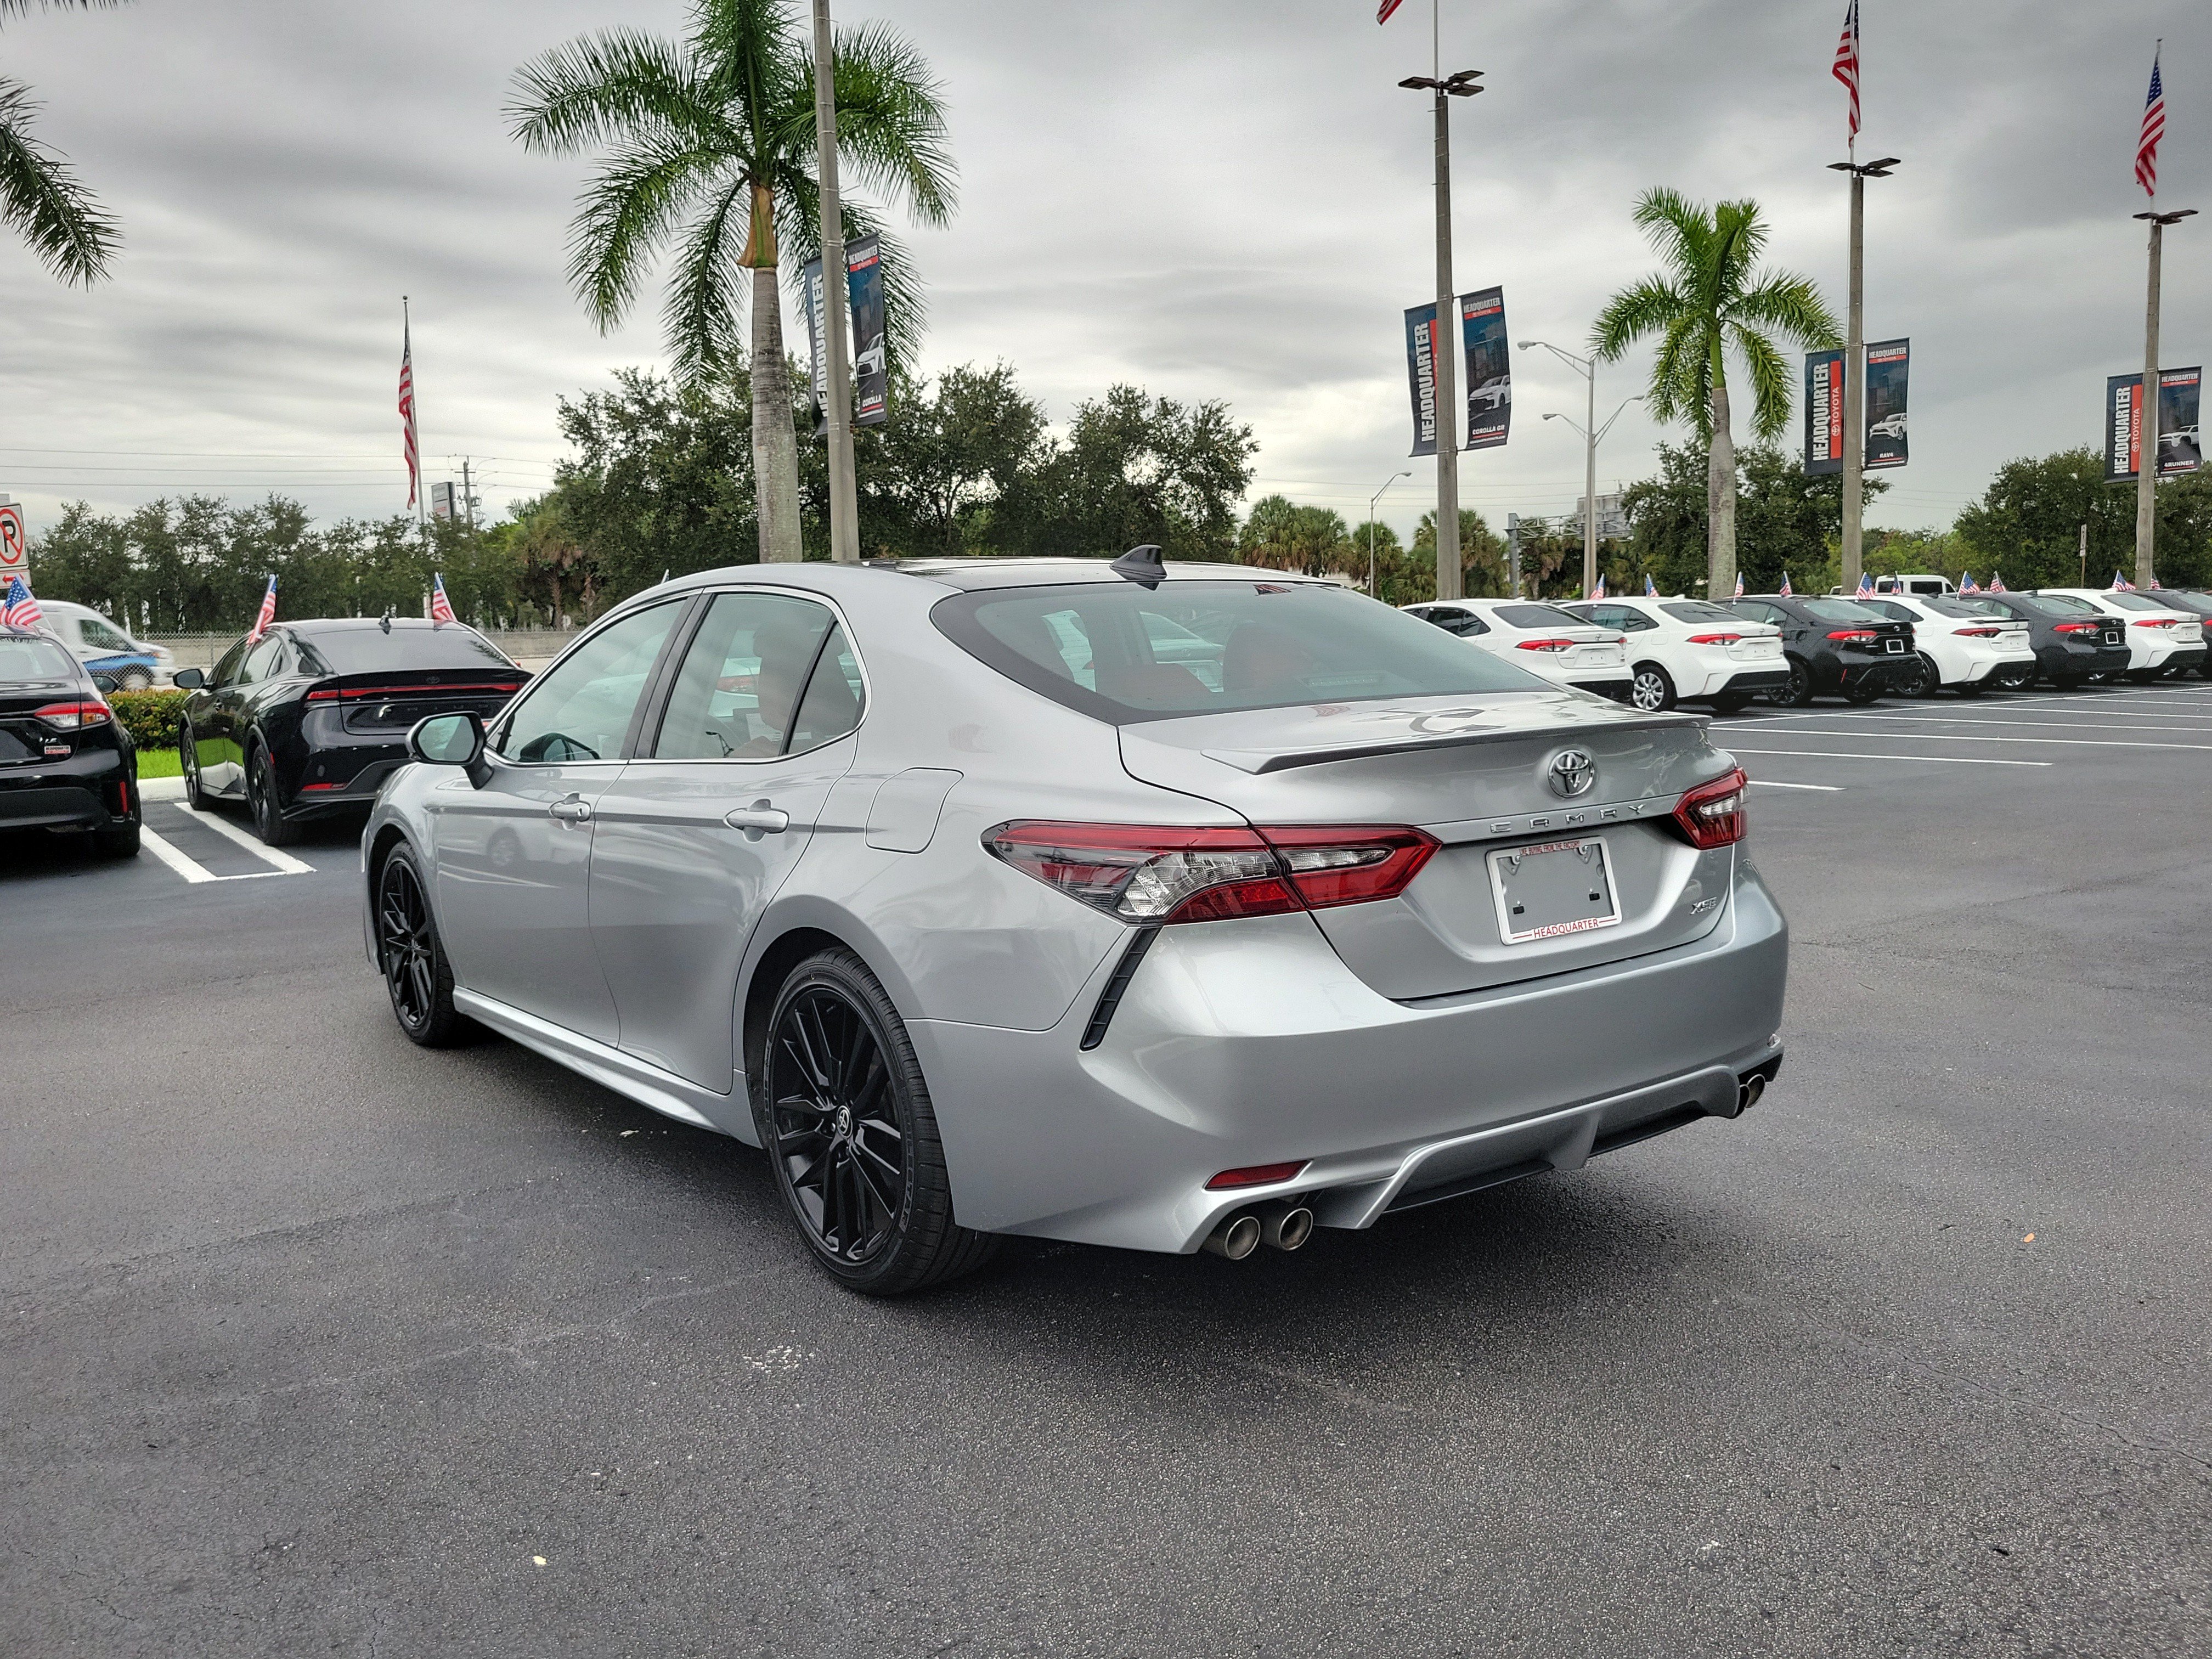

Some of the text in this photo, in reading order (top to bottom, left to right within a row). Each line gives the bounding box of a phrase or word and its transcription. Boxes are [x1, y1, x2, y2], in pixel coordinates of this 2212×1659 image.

[1464, 297, 1500, 313] HEADQUARTER
[1869, 347, 1906, 358] HEADQUARTER
[1414, 323, 1435, 442] HEADQUARTER
[2162, 374, 2198, 382] HEADQUARTER
[1813, 363, 1830, 461] HEADQUARTER
[1472, 426, 1496, 435] COROLLA
[2114, 386, 2131, 474] HEADQUARTER
[1490, 803, 1645, 833] CAMRY
[1690, 896, 1717, 915] XSE
[1534, 918, 1599, 938] HEADQUARTER
